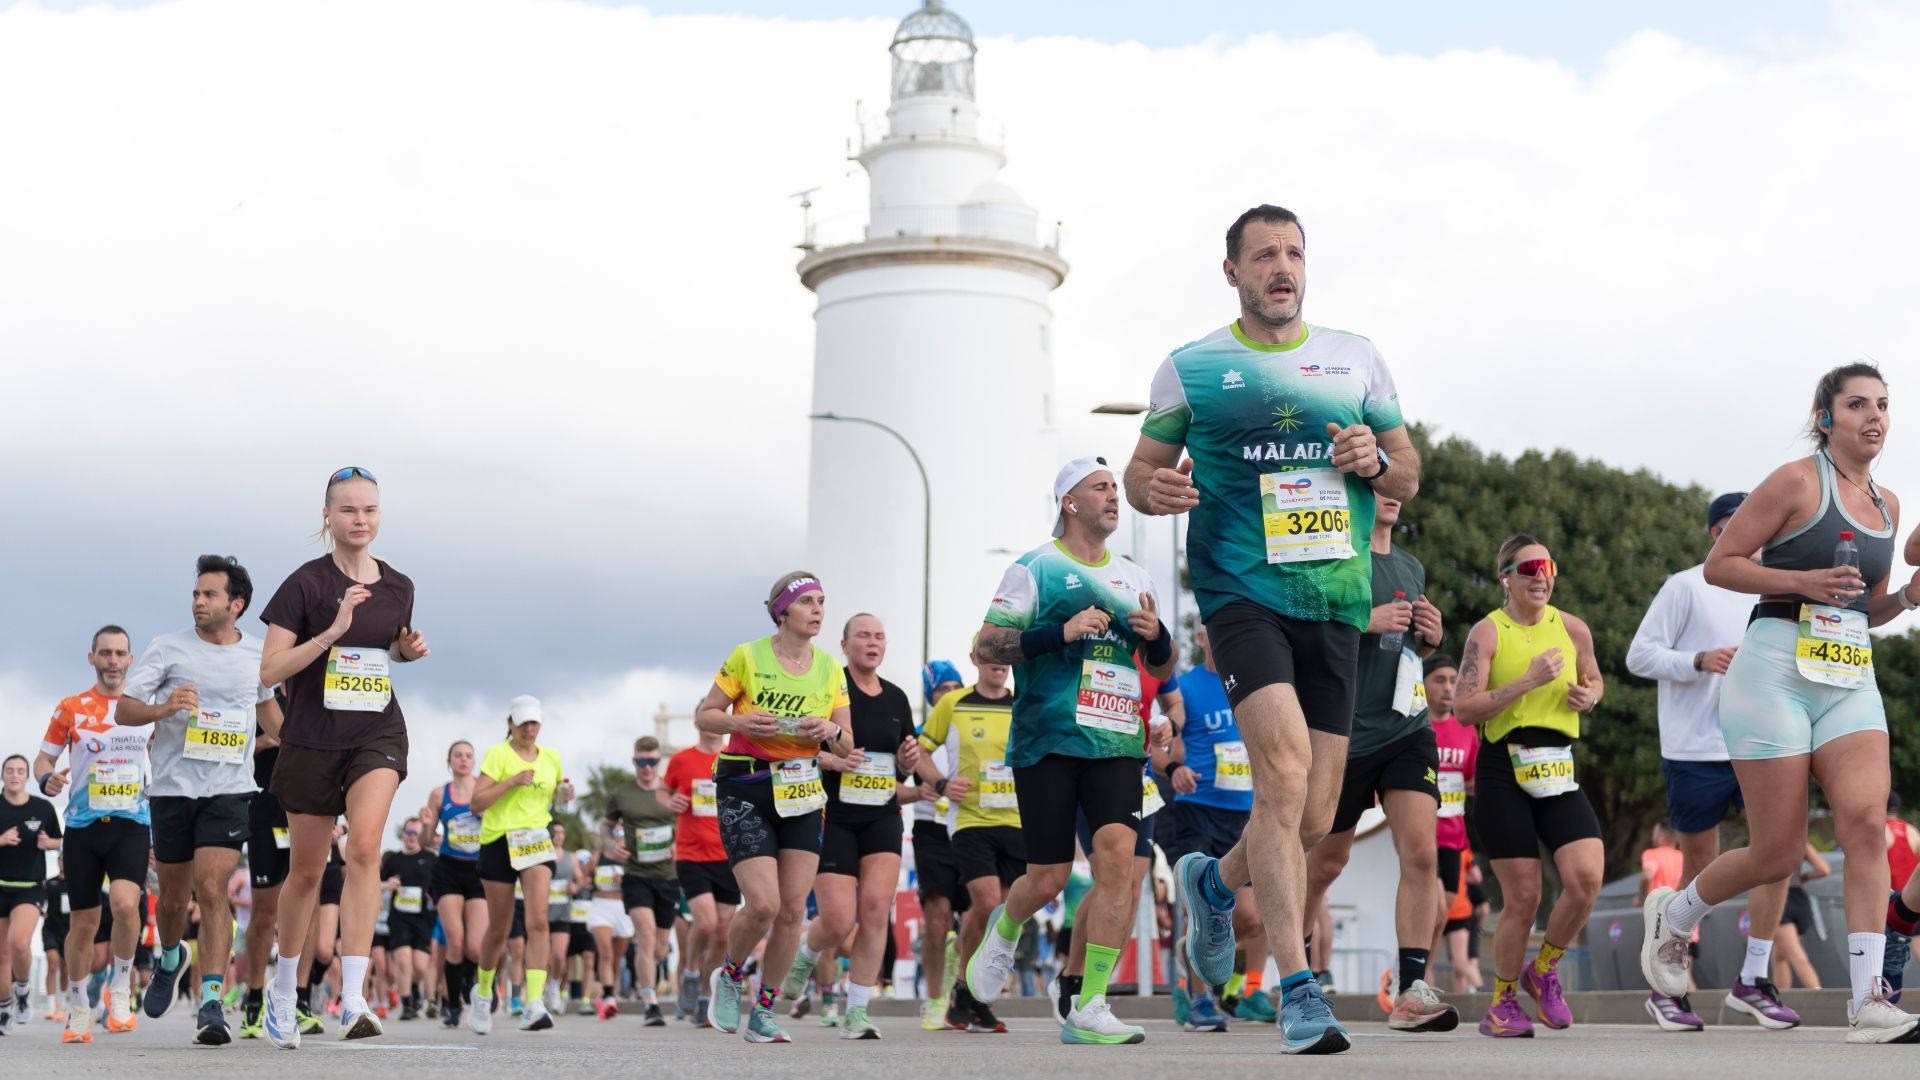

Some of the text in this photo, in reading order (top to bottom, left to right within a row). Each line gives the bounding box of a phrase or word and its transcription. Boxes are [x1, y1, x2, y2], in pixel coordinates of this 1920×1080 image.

[1222, 382, 1246, 391] luanvi
[1287, 509, 1343, 535] 3206
[788, 577, 816, 593] RUN
[1093, 645, 1114, 657] 20
[1810, 642, 1862, 666] F4336
[335, 675, 384, 692] F5265
[1091, 692, 1133, 715] 10060
[201, 730, 238, 747] 1838
[1228, 763, 1249, 775] 381
[1525, 763, 1566, 780] F4510
[99, 784, 132, 796] 4645
[784, 783, 818, 800] F2894
[992, 781, 1014, 794] 381
[1654, 913, 1662, 939] HOKA
